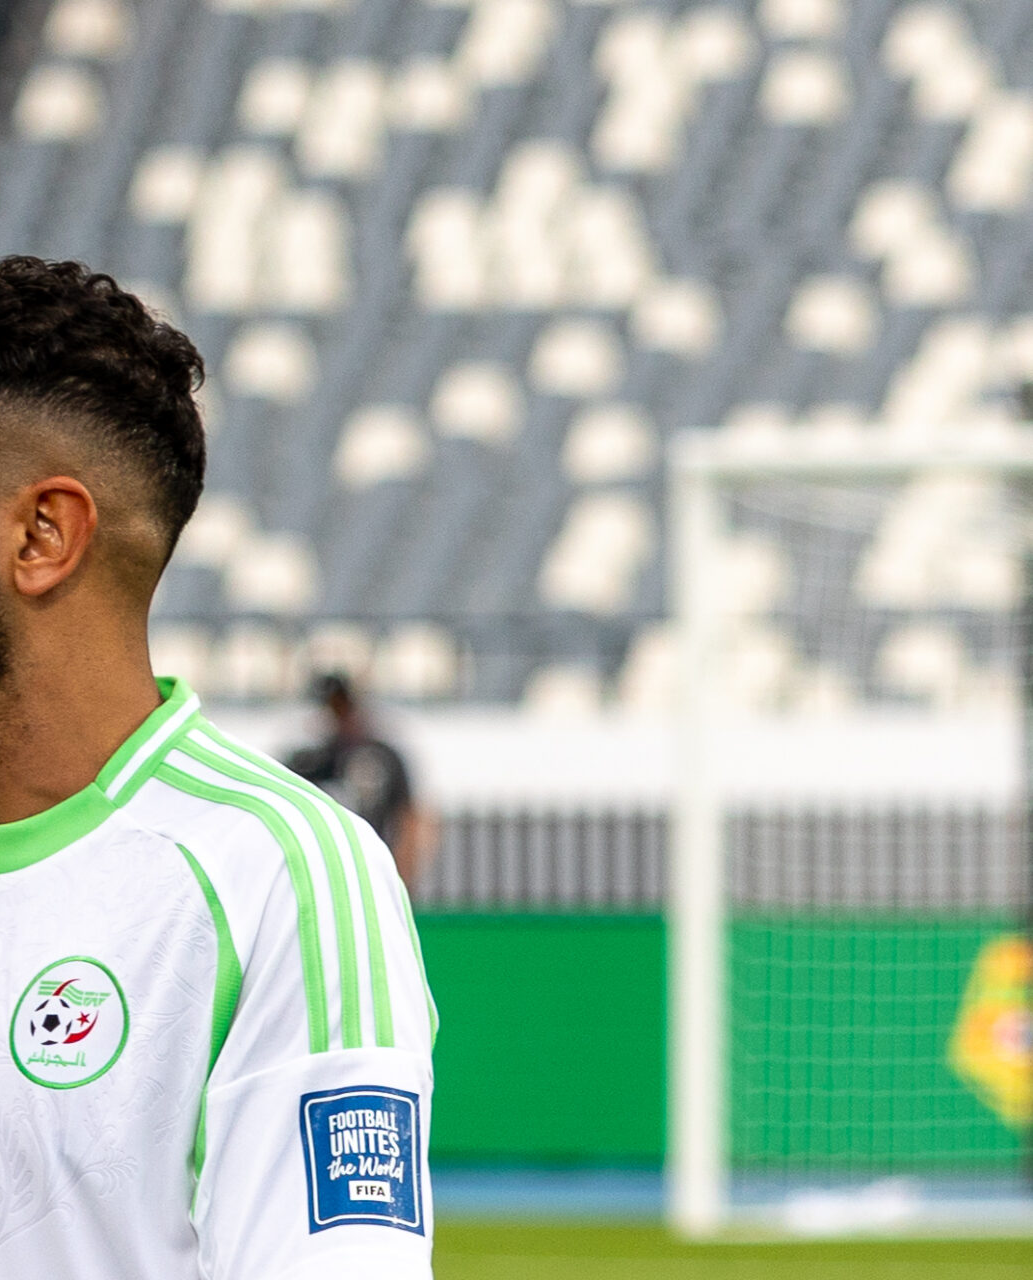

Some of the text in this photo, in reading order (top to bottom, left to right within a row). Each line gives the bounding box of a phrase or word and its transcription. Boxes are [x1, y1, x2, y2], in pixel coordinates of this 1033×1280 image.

[328, 1109, 399, 1133] FOOTBALL
[330, 1129, 400, 1157] UNITES
[327, 1155, 404, 1183] the World
[355, 1185, 386, 1197] FIFA
